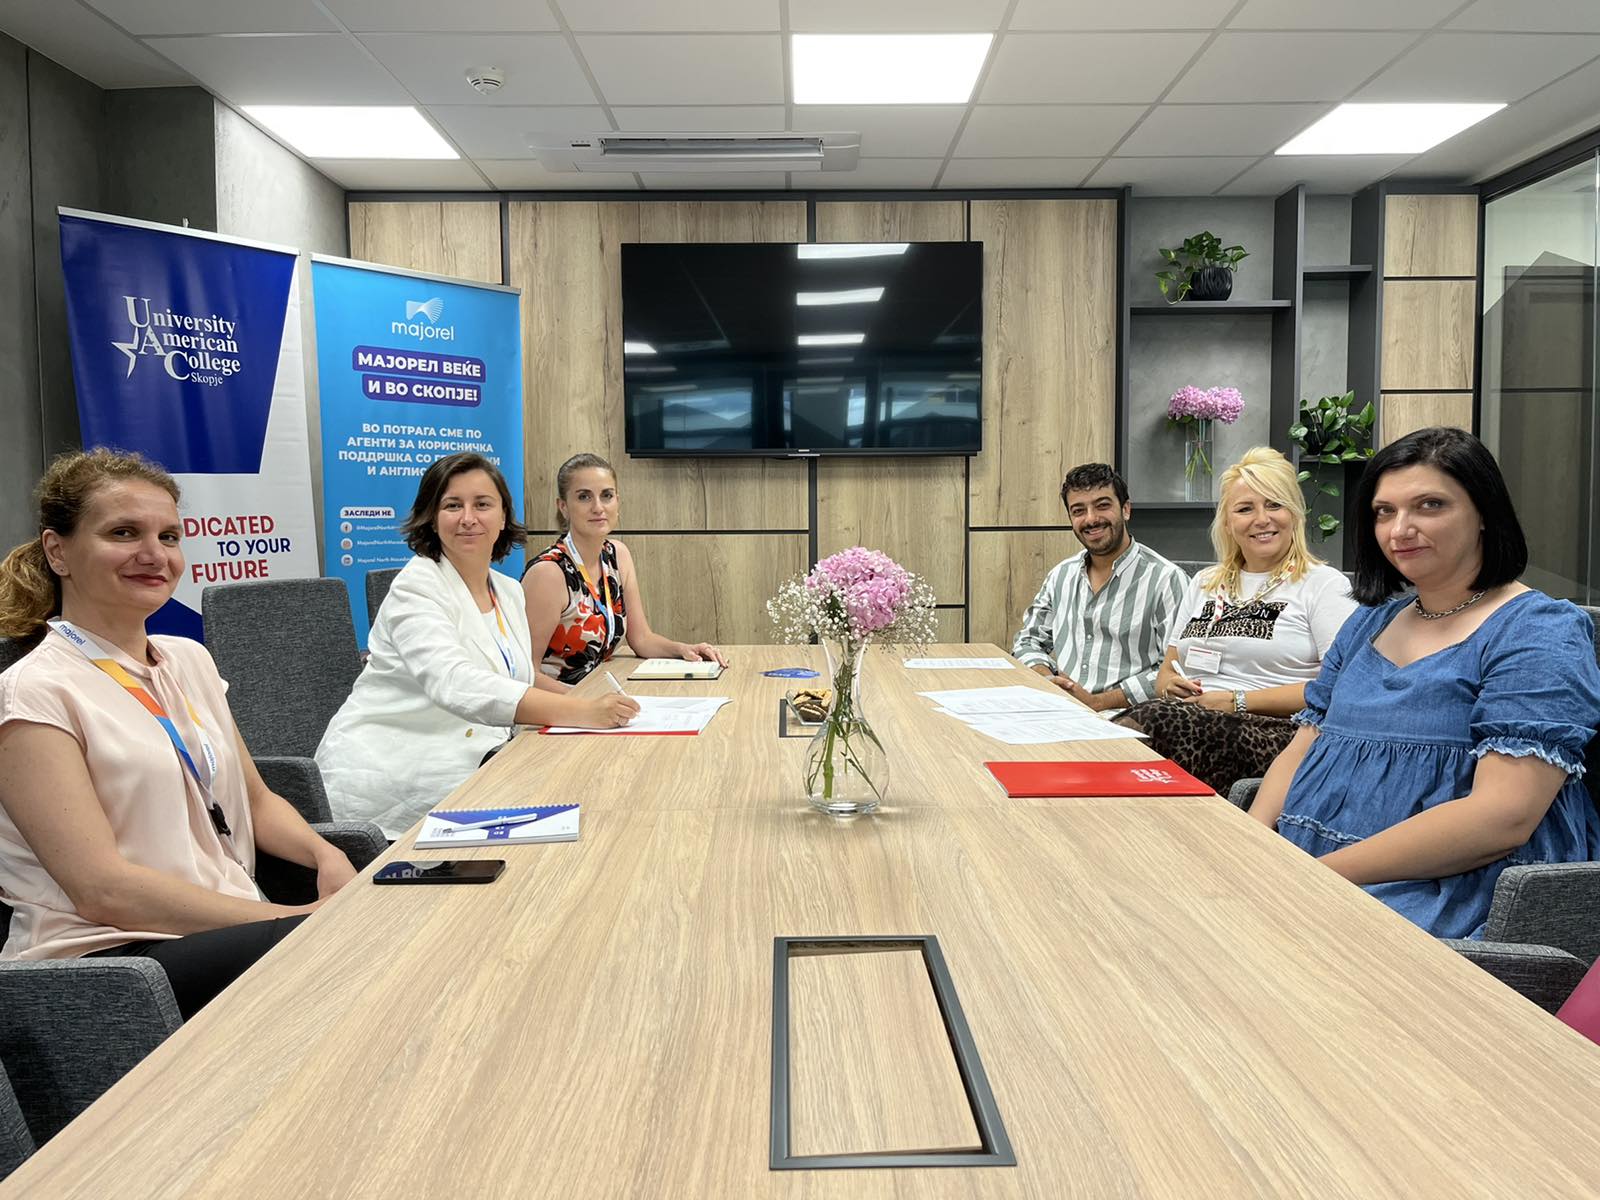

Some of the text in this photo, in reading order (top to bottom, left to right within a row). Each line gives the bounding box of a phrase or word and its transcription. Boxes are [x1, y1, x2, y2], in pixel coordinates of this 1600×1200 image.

[122, 296, 236, 337] University
[139, 325, 239, 356] American
[391, 321, 454, 341] majorel
[163, 350, 241, 380] College
[358, 352, 481, 377] МАЈОРЕЛ ВЕЌЕ
[191, 372, 223, 386] Skopje
[368, 380, 478, 401] И ВО СКОПЈЕ!
[362, 423, 482, 439] ВО ПОТРАГА СМЕ ПО
[347, 437, 494, 453] АГЕНТИ ЗА КОРИСНИЧКА
[338, 450, 413, 463] ПОДДРШКА
[416, 454, 432, 463] СО
[367, 466, 426, 477] И АНГЛИС
[344, 509, 392, 517] ЗАСЛЕДИ НЕ
[183, 515, 275, 538] DICATED
[217, 538, 291, 557] TO YOUR
[191, 559, 269, 583] FUTURE
[59, 623, 86, 646] majorel
